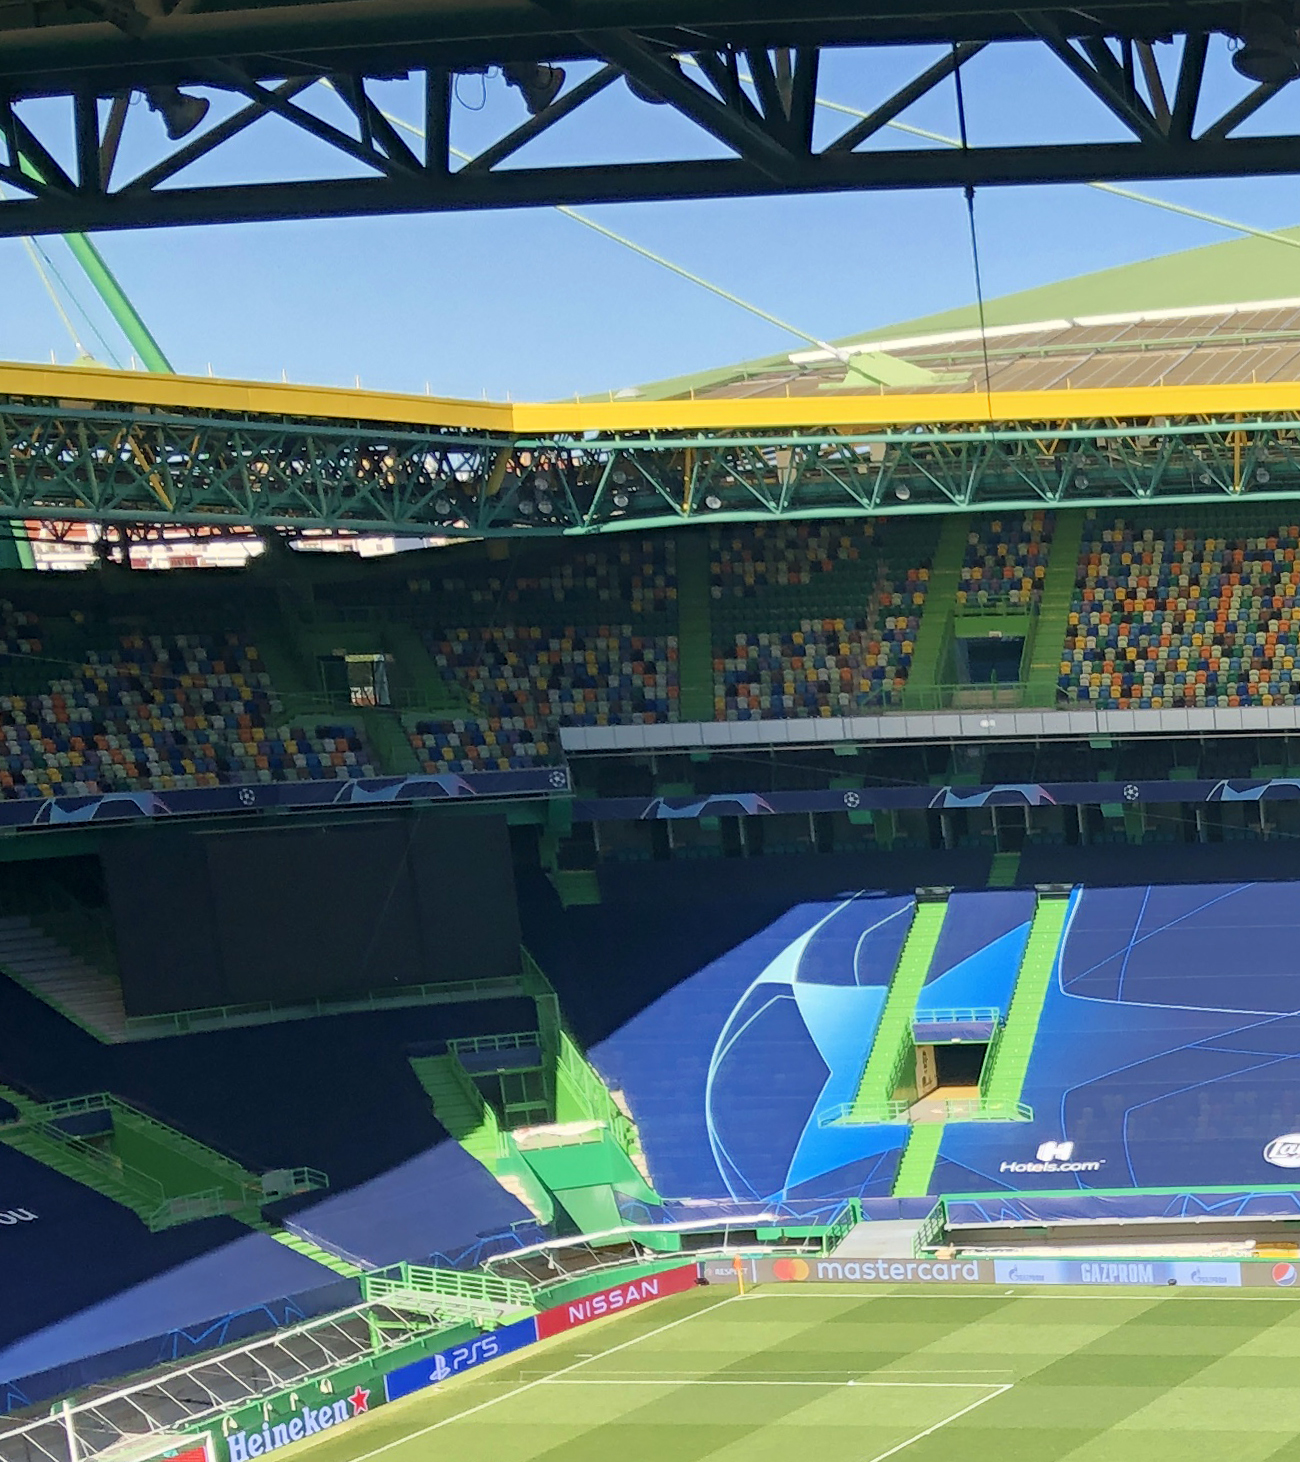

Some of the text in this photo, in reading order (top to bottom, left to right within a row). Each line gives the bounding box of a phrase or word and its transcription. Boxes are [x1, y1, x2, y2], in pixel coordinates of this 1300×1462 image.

[1000, 1161, 1099, 1173] Hotels.com
[818, 1260, 979, 1281] mastercard
[1080, 1263, 1154, 1283] GAZPROM
[568, 1279, 658, 1323] NISSAN
[452, 1335, 499, 1369] PS5
